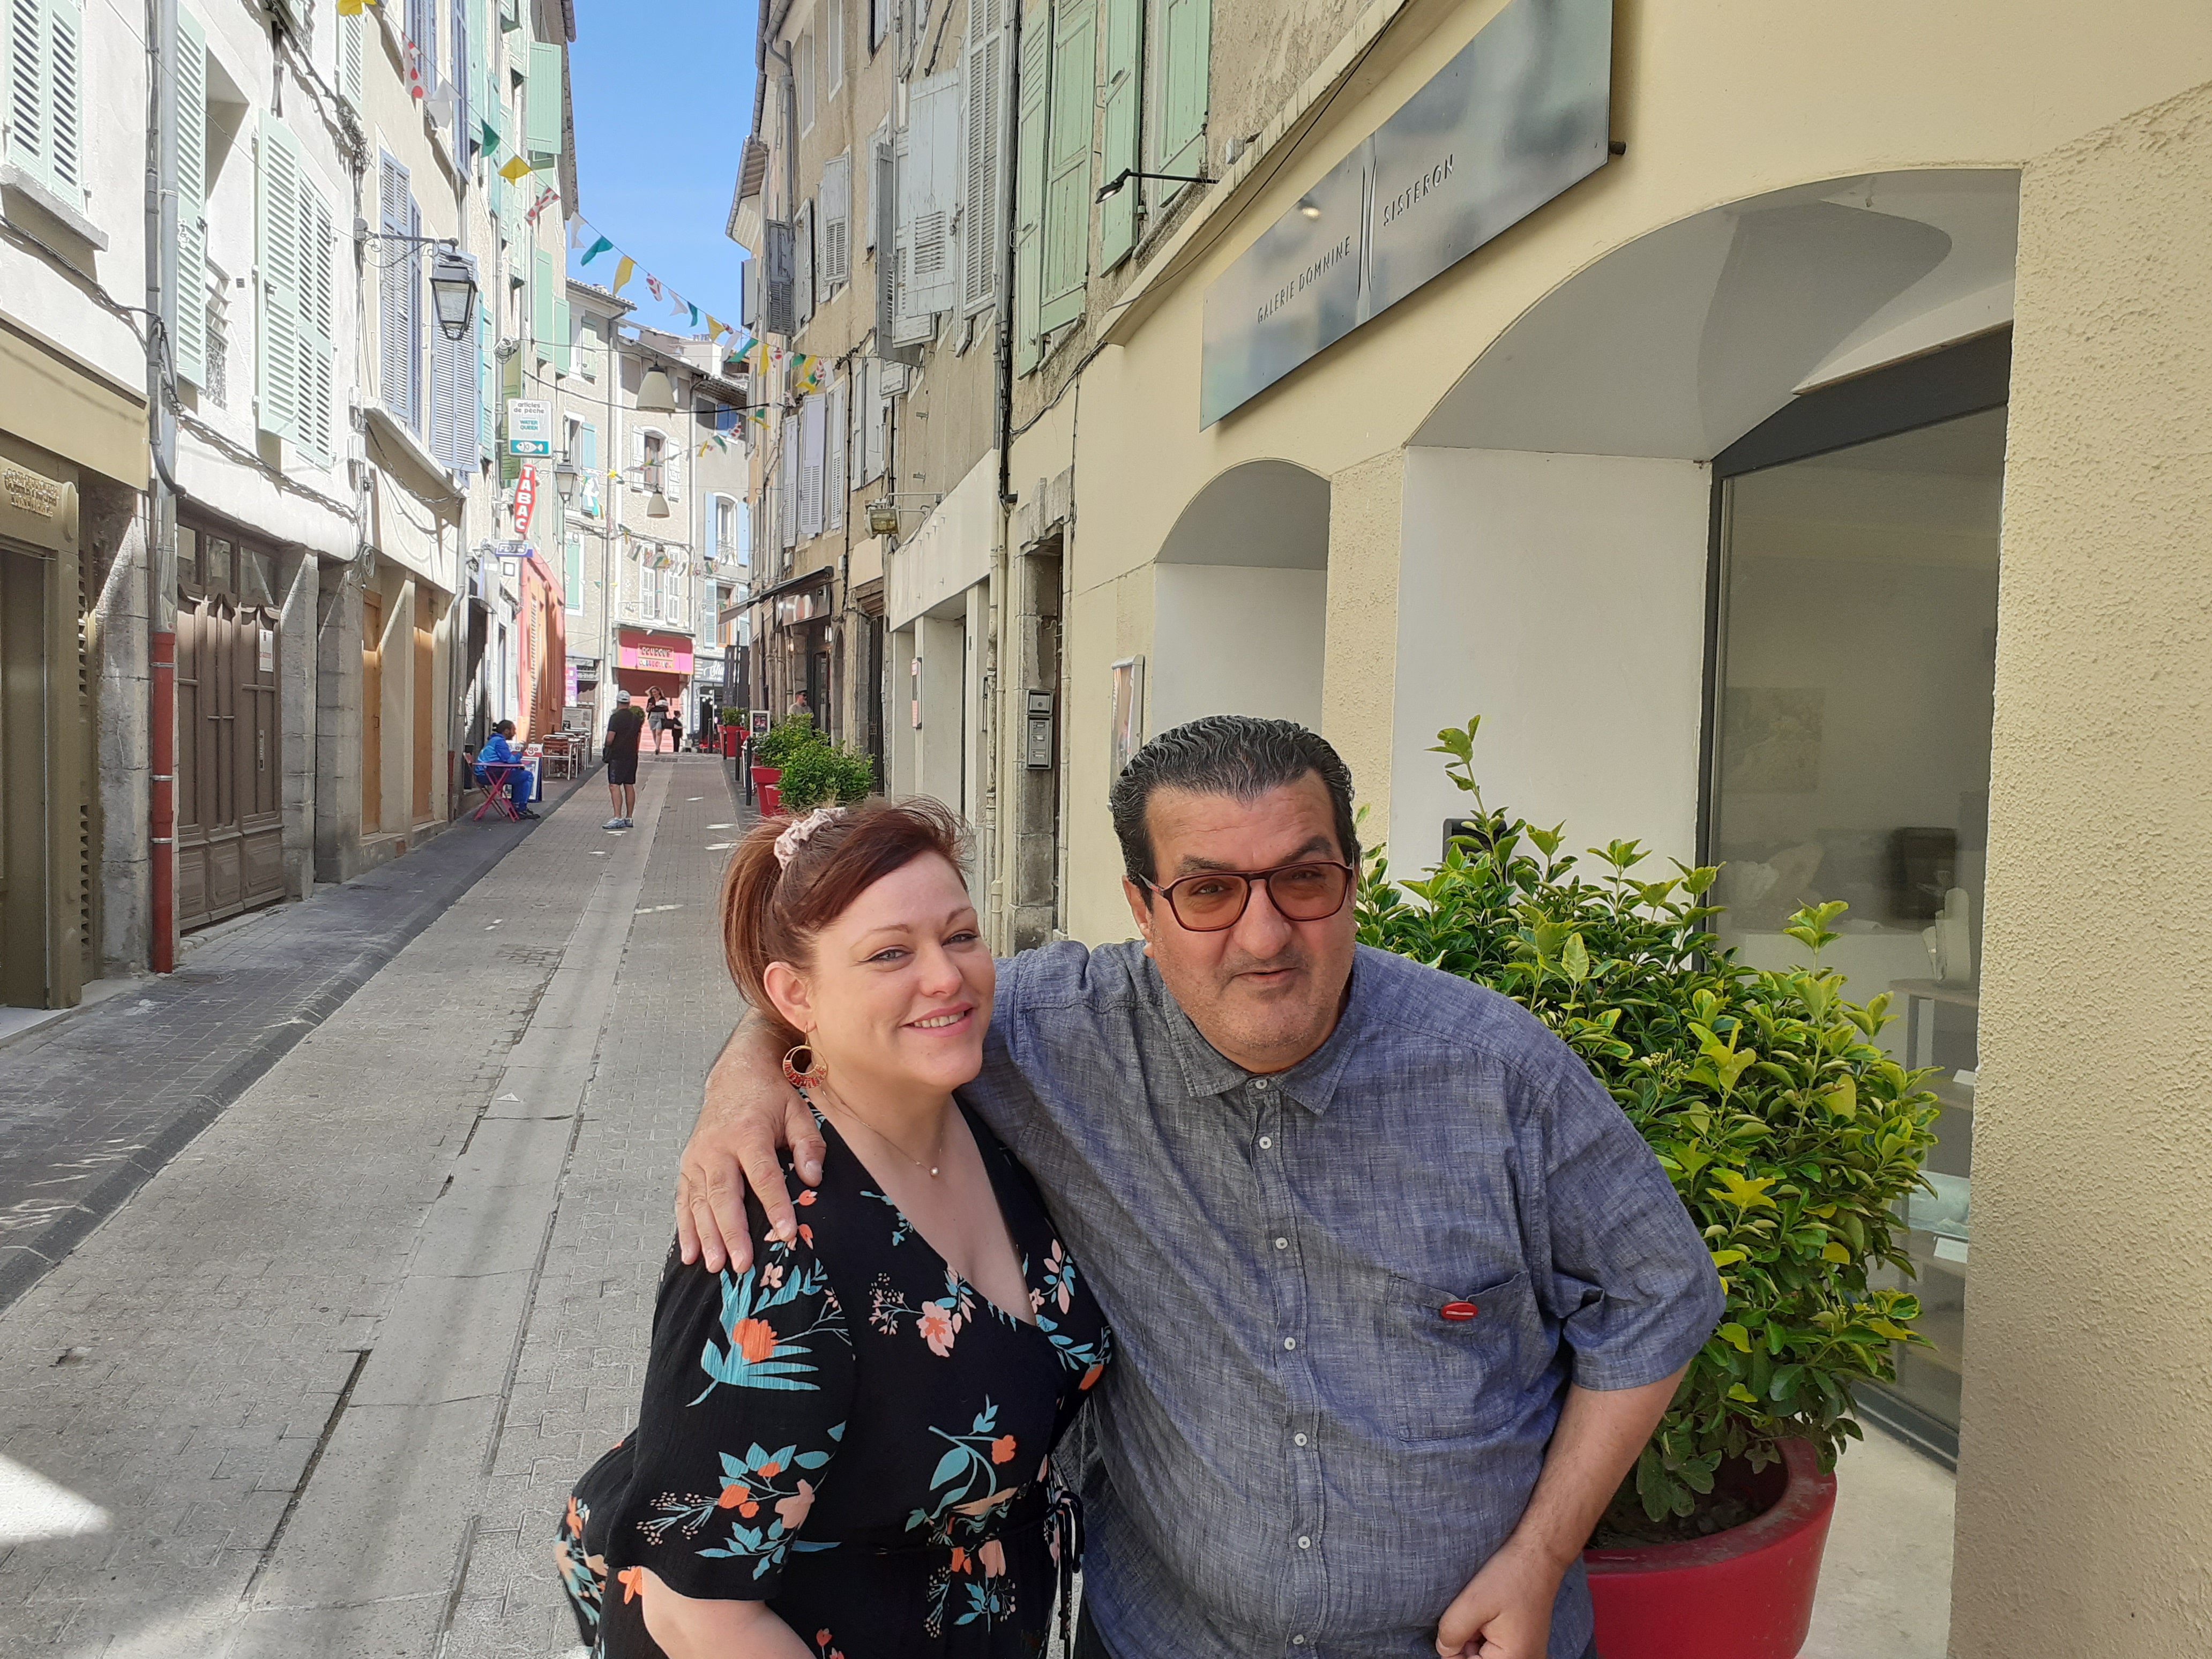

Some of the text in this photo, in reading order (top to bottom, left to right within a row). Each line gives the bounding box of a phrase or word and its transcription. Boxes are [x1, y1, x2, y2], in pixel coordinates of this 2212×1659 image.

[1258, 154, 1454, 324] GALERIE DOMNINE SISTERON
[515, 466, 533, 530] TABAC
[498, 544, 517, 552] FDJ
[515, 745, 539, 754] aigo
